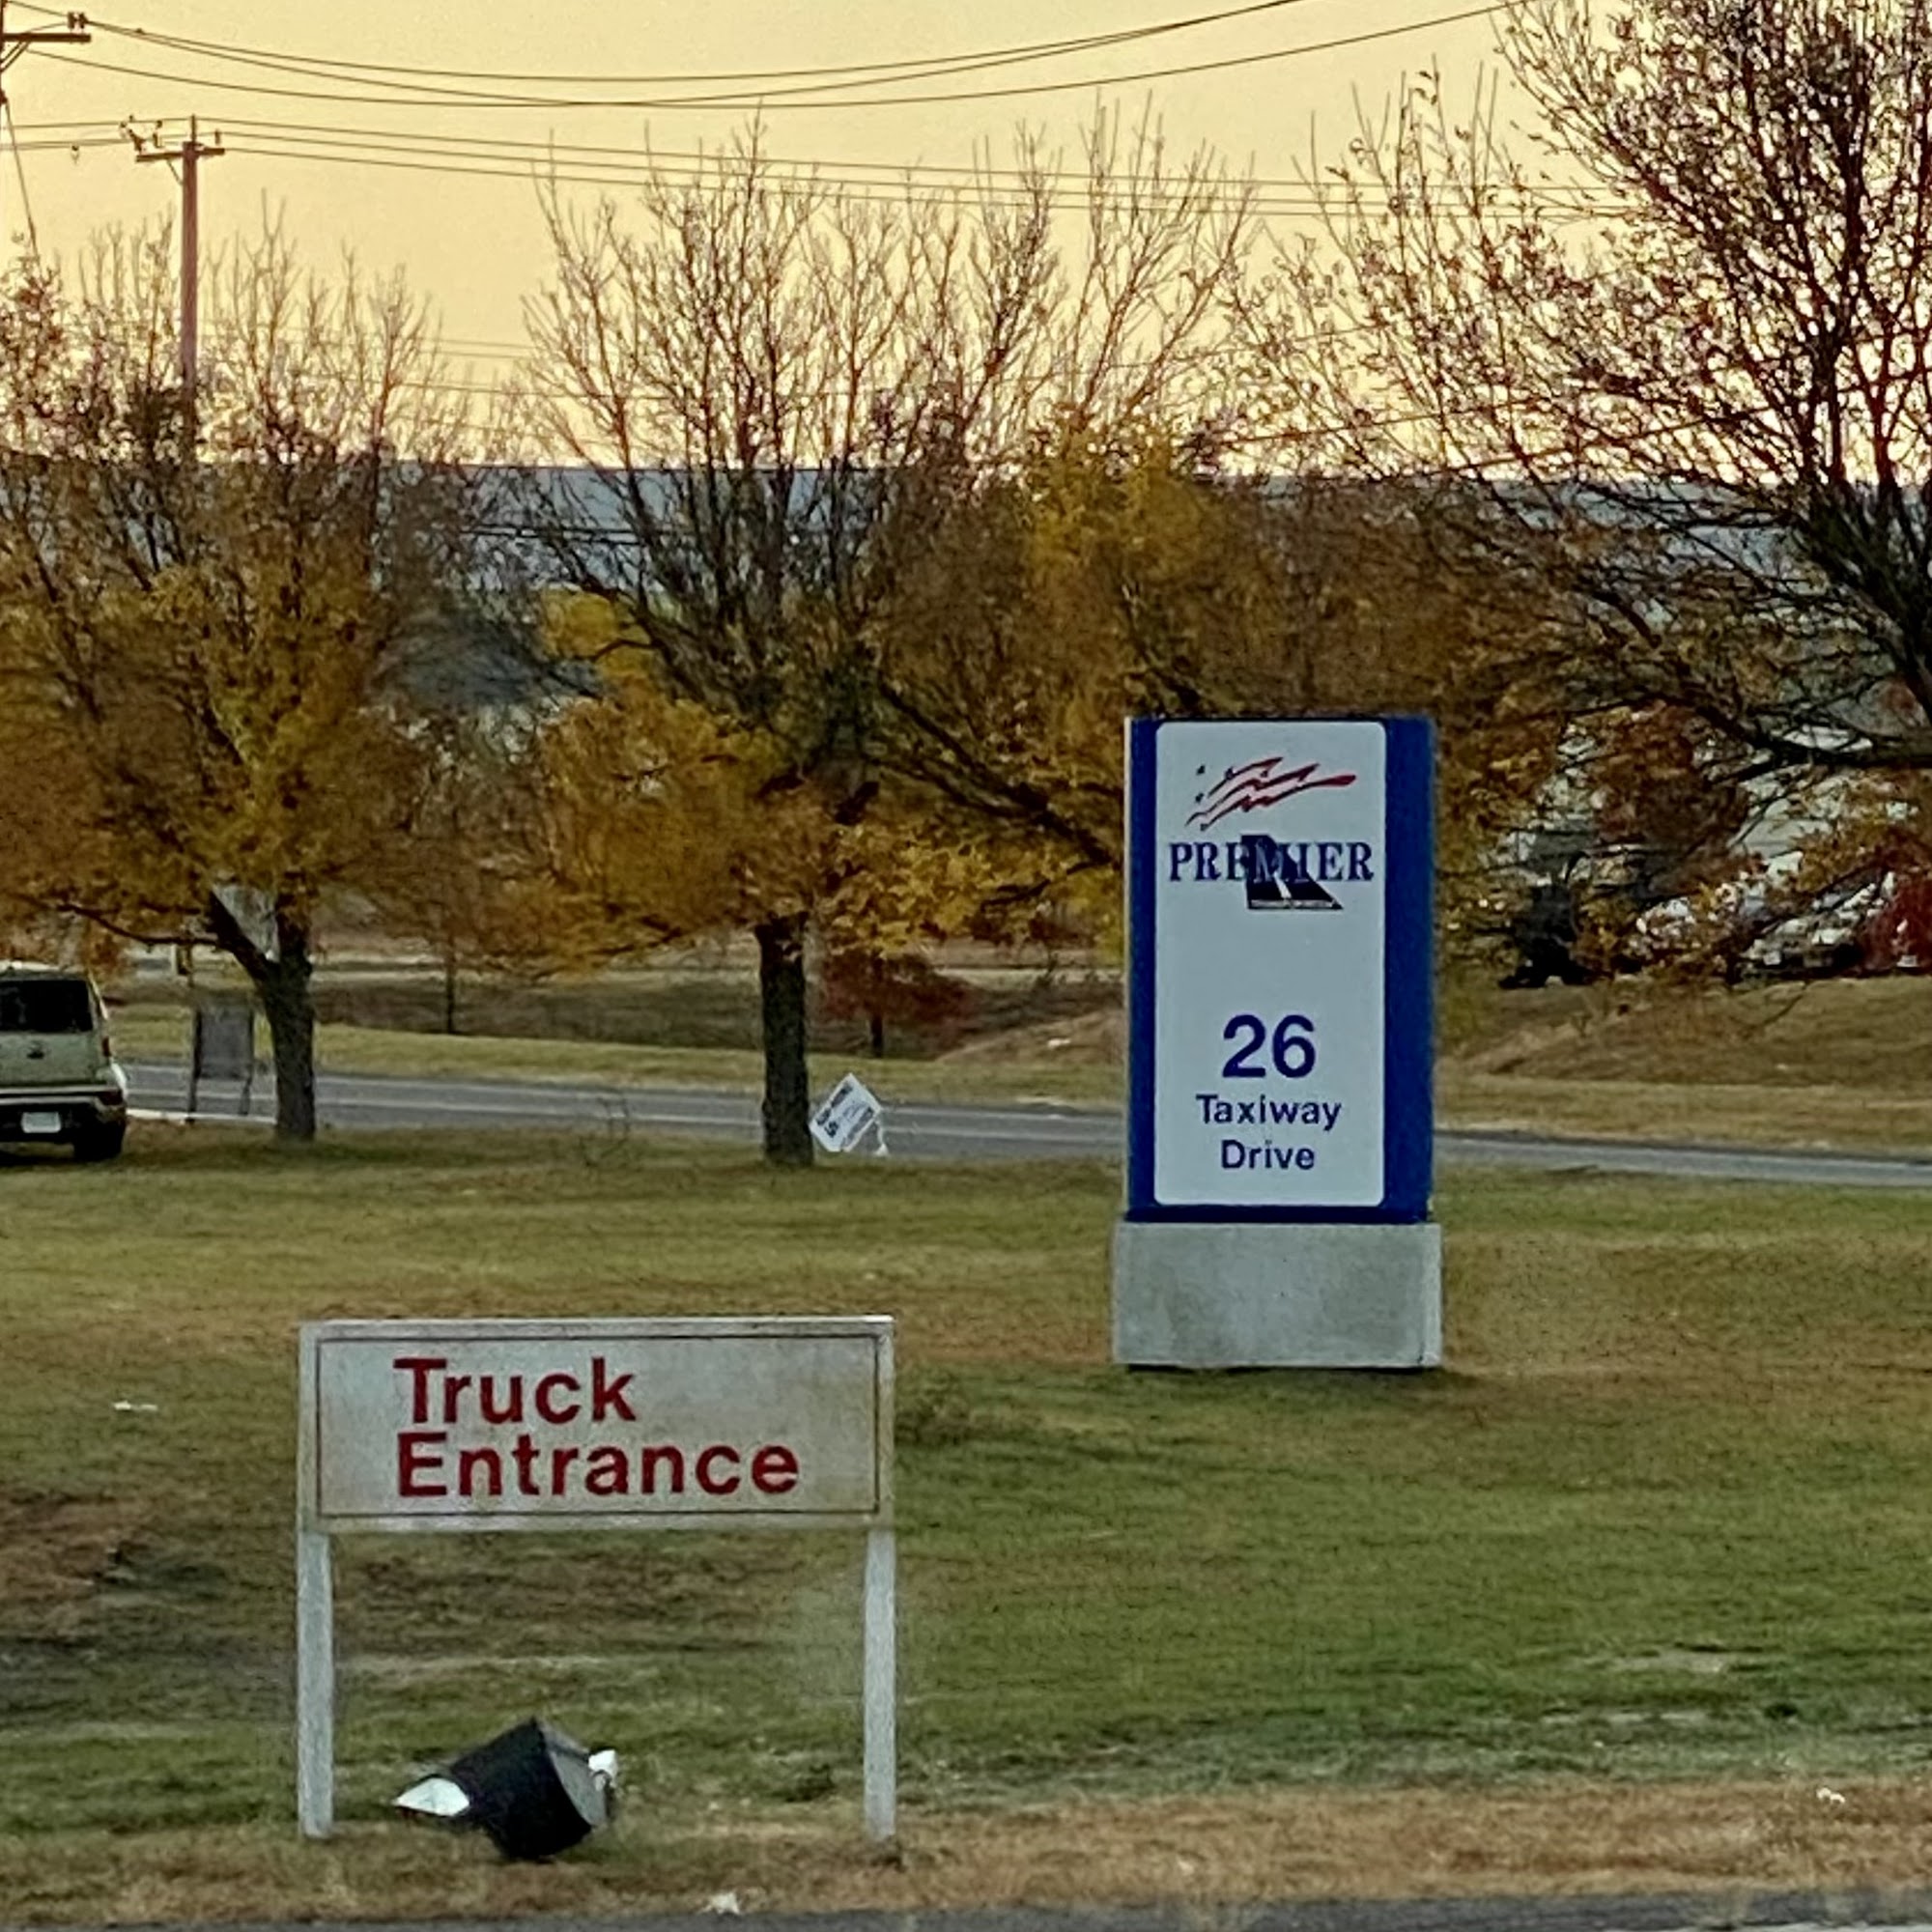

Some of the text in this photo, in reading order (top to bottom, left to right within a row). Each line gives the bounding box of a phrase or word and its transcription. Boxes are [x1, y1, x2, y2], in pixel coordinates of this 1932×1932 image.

[1169, 841, 1374, 882] PREMIER
[1222, 1014, 1317, 1078] 26
[1196, 1094, 1342, 1131] Taxiway
[1221, 1139, 1316, 1170] Drive
[393, 1357, 637, 1424] Truck
[397, 1432, 800, 1496] Entrance
